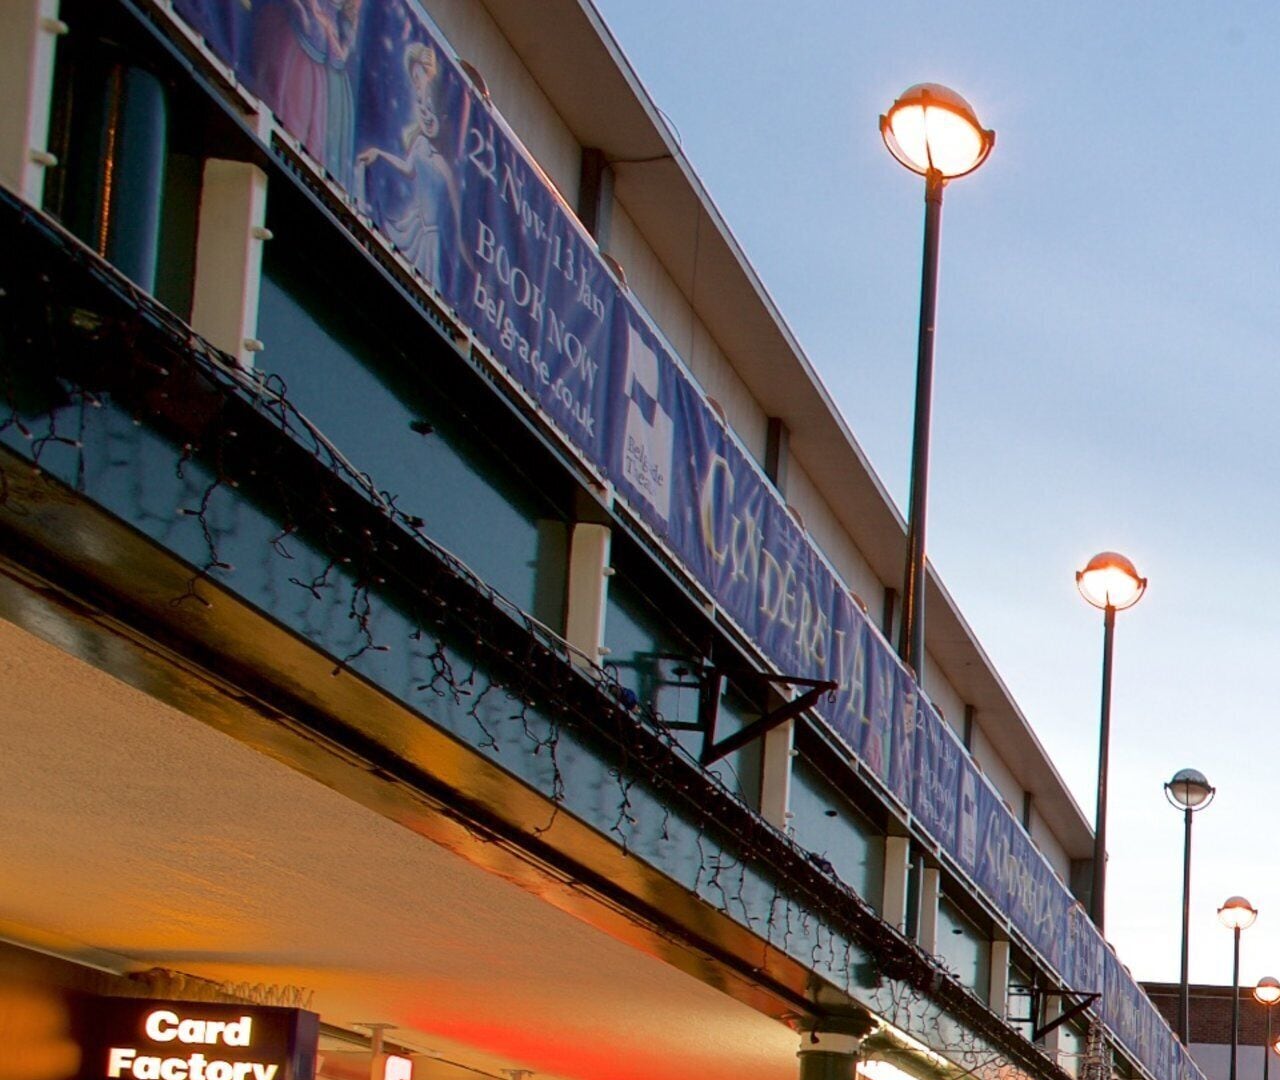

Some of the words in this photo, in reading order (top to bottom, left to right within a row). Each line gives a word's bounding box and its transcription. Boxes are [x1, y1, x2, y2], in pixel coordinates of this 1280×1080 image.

[469, 128, 498, 186] 22
[475, 219, 546, 323] BOOK
[548, 308, 600, 388] NOW
[701, 454, 871, 724] CINDERELA
[145, 1010, 252, 1047] Card
